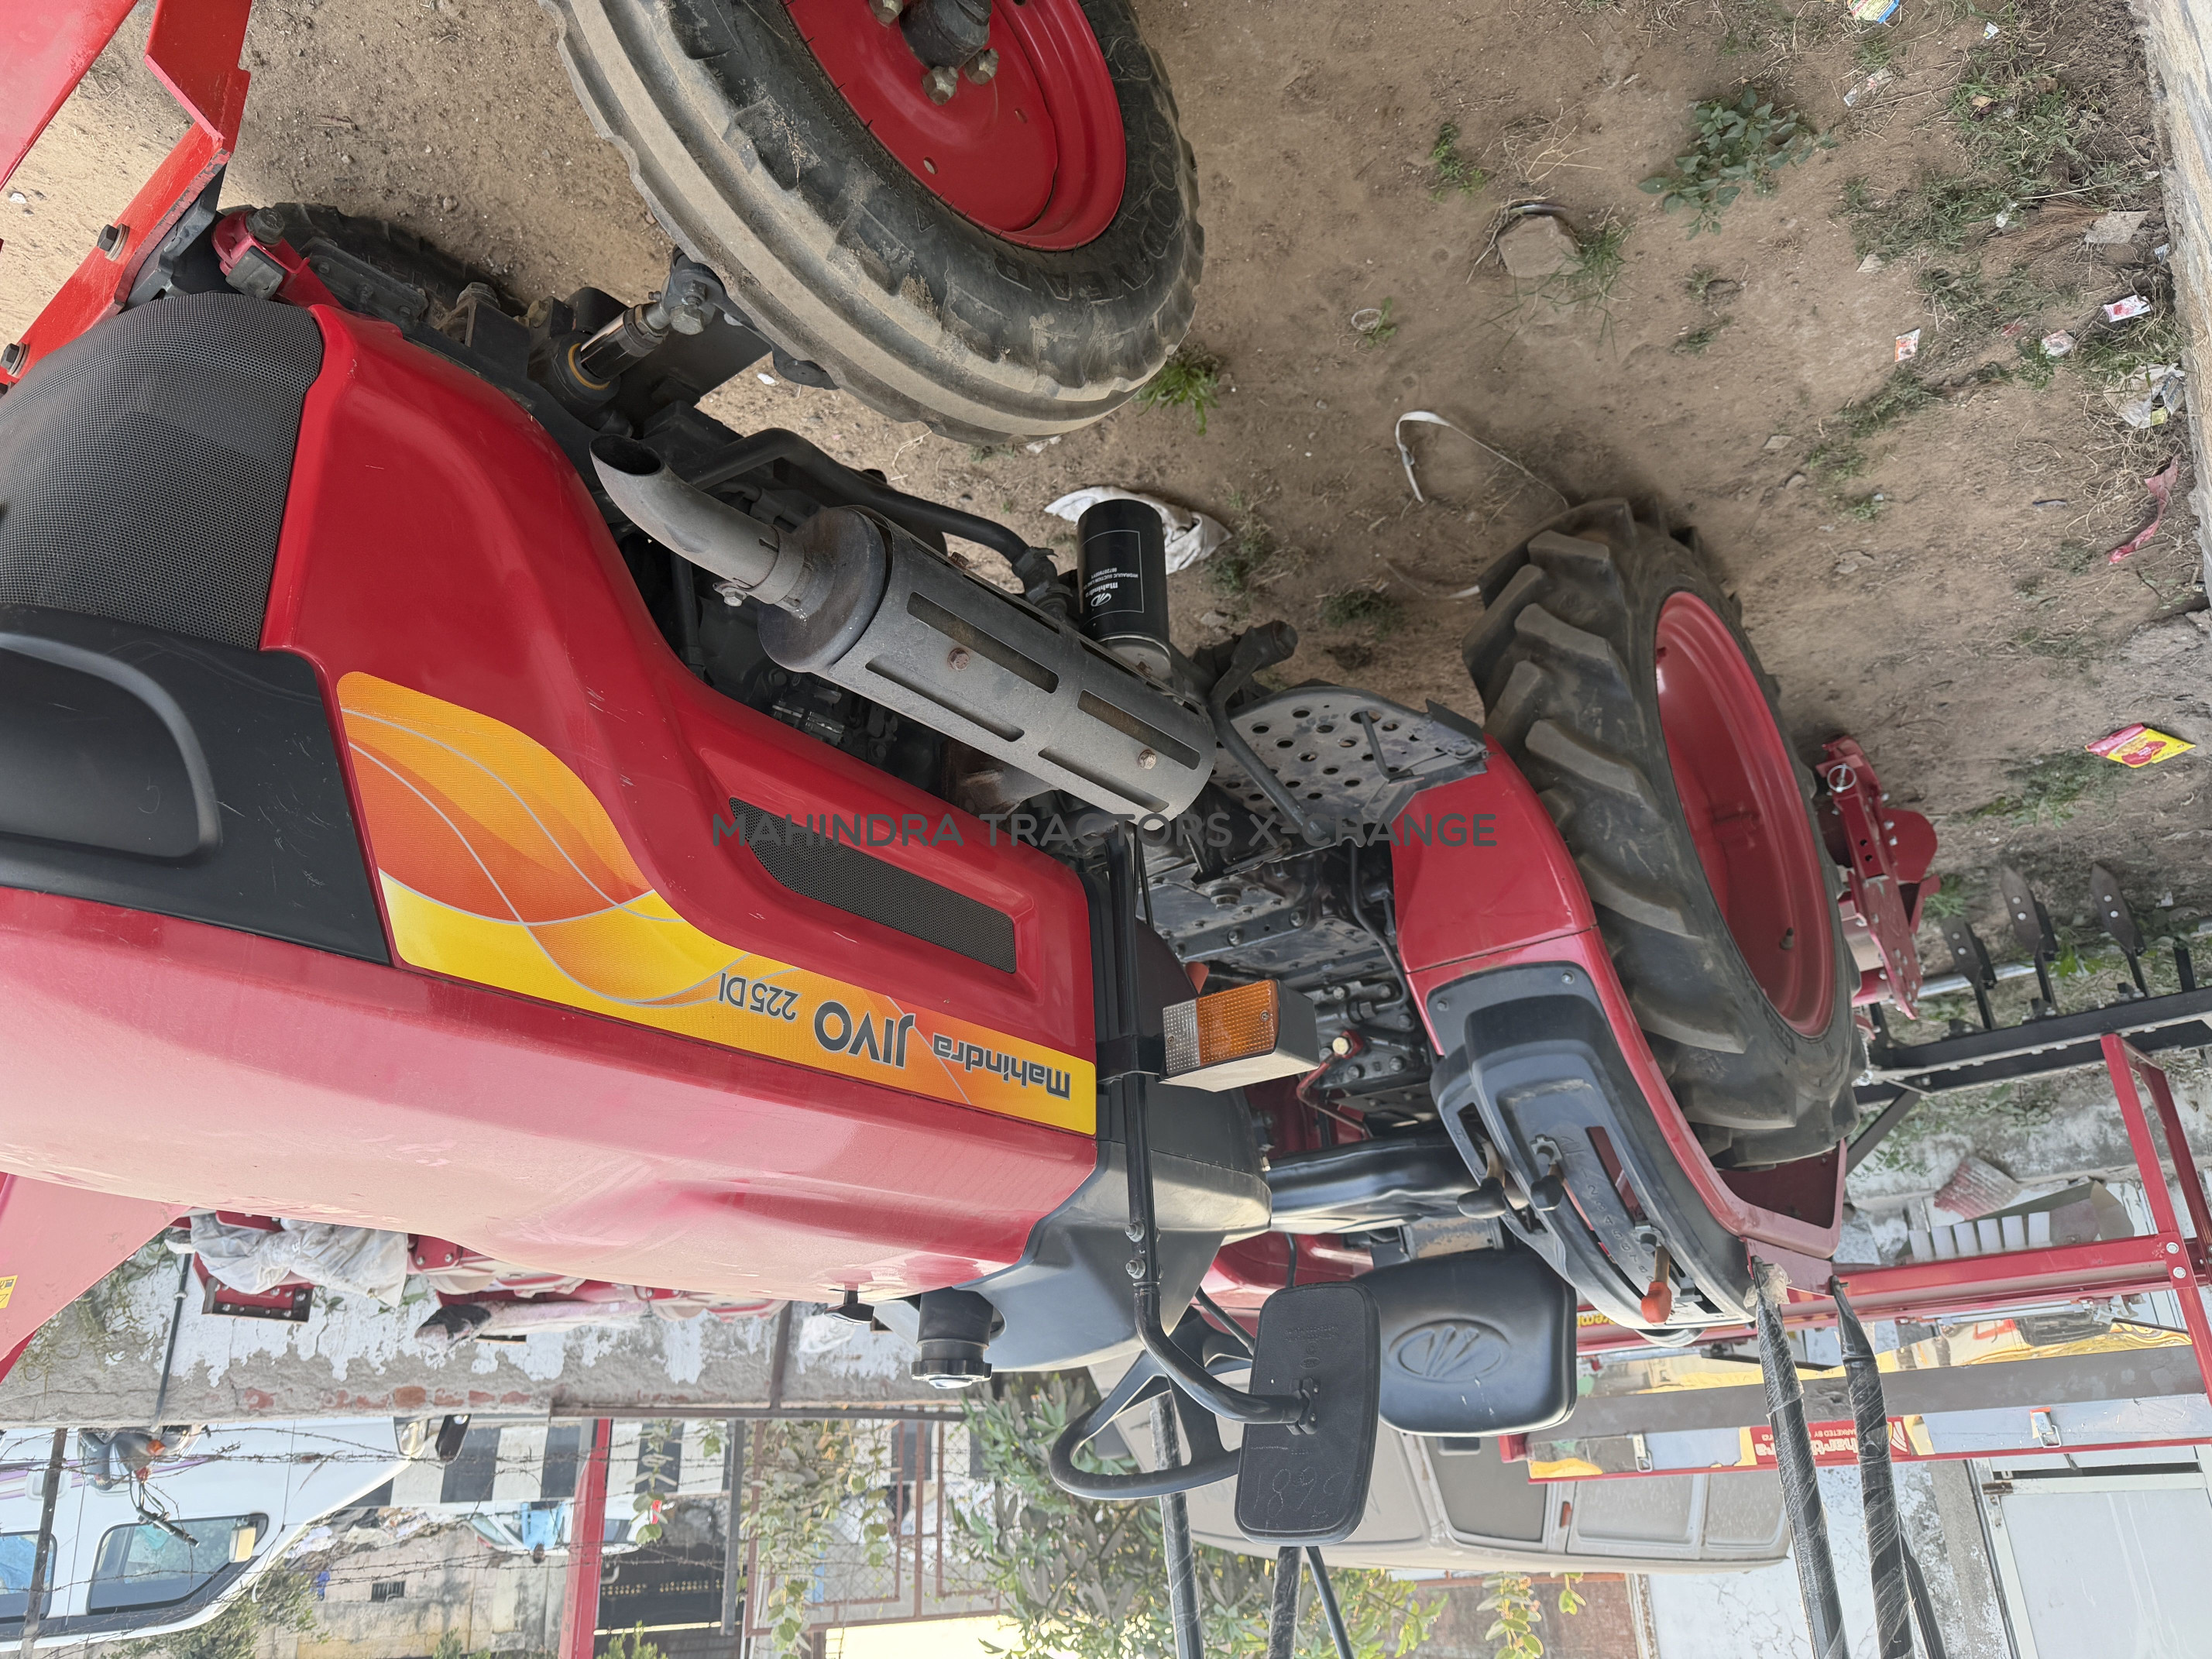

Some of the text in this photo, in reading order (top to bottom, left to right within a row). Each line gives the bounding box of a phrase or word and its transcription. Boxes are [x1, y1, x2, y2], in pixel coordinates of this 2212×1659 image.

[1085, 582, 1118, 598] Mahindra
[750, 981, 800, 1022] 225
[813, 1001, 915, 1070] JIVO
[932, 1033, 1071, 1100] Mahindra
[1809, 1437, 1859, 1458] harti
